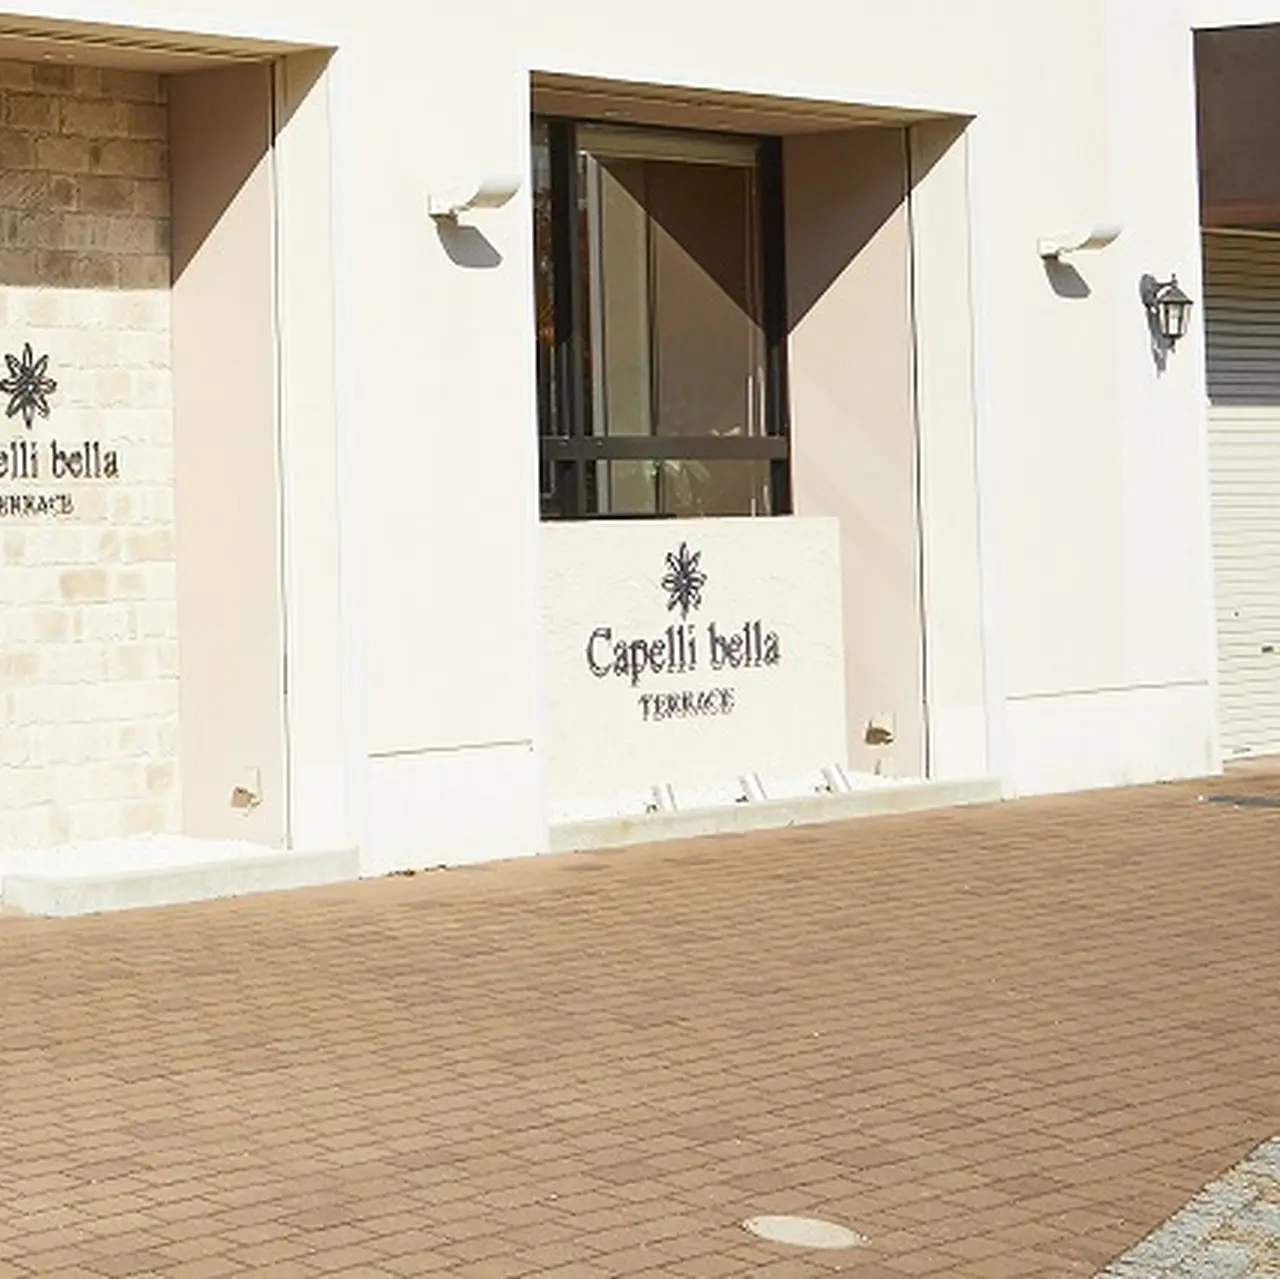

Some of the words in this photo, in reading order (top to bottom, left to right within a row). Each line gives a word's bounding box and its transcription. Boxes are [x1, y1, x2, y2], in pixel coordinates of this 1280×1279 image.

[50, 439, 119, 479] bella
[586, 623, 696, 687] Capelli
[707, 619, 781, 671] bella
